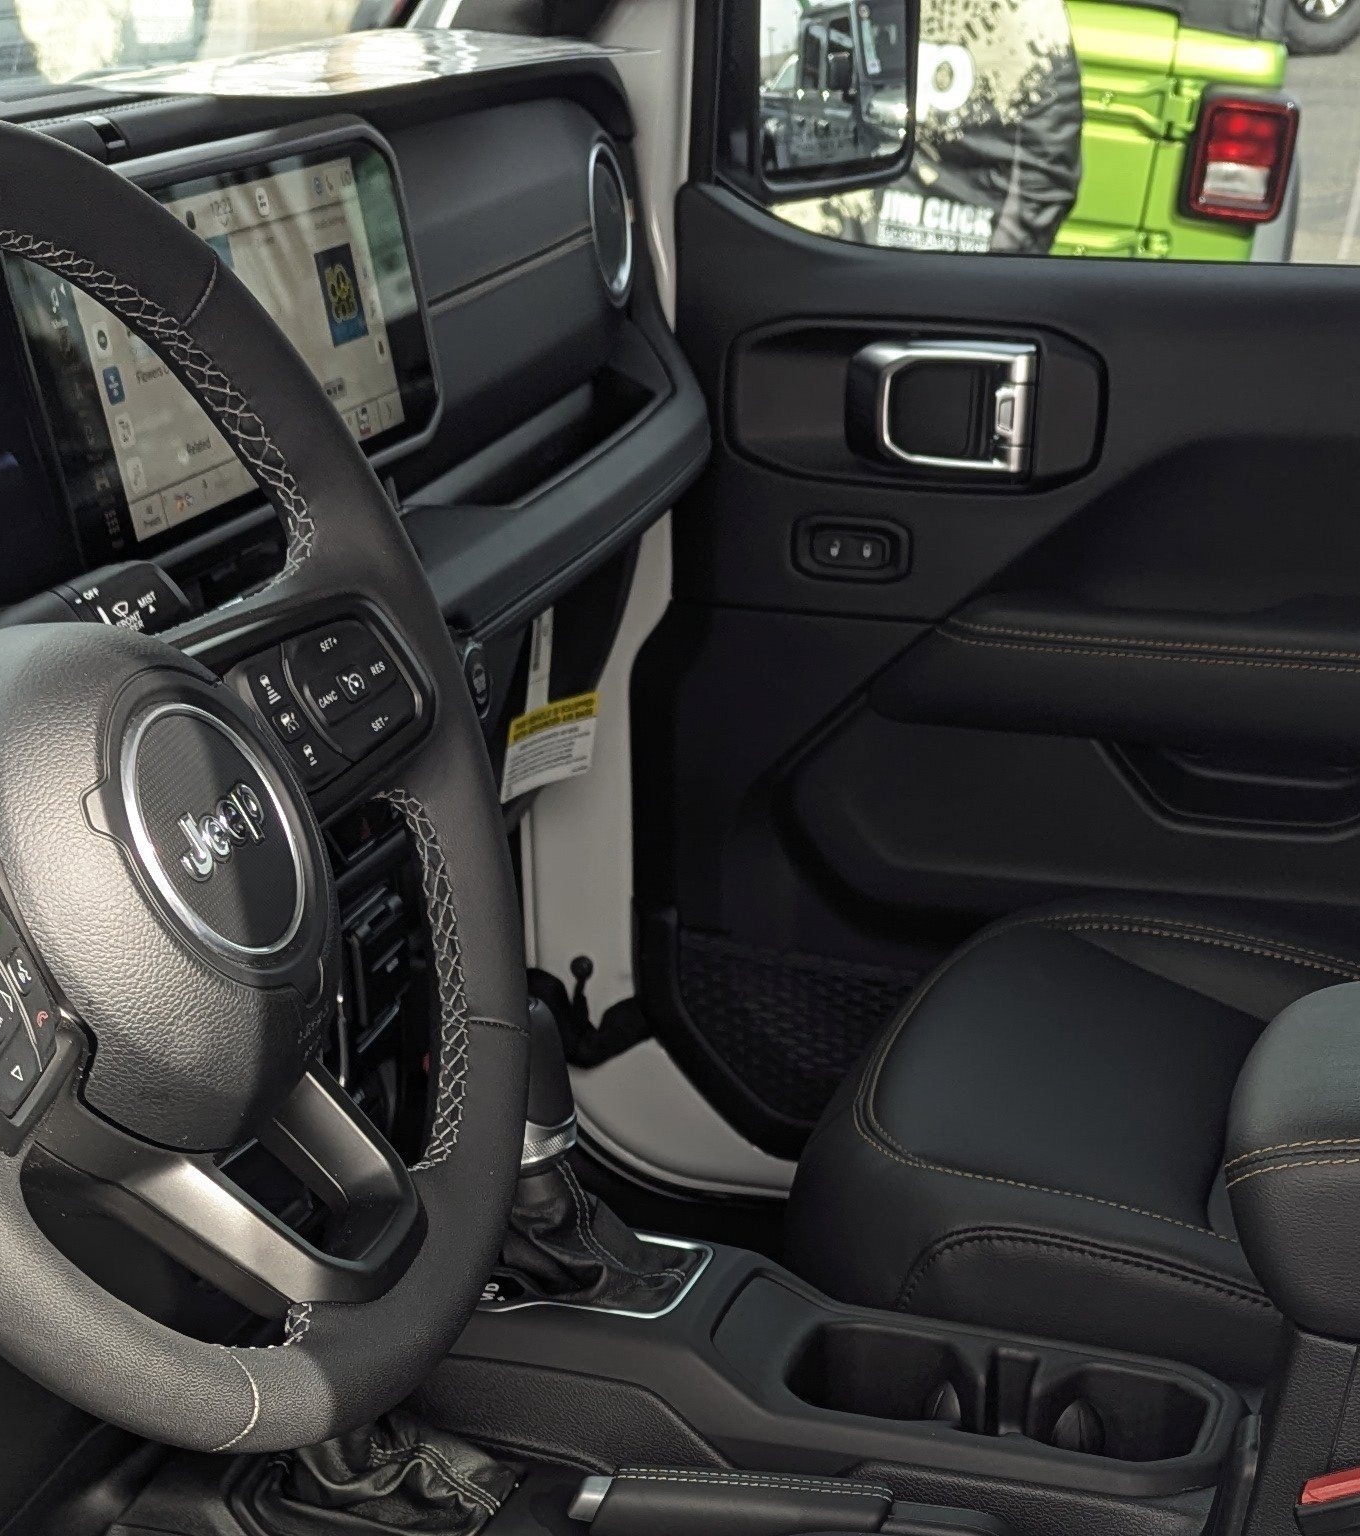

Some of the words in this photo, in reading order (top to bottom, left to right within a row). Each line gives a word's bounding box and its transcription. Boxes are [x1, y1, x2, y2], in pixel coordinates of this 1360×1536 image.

[82, 587, 100, 601] OFF
[136, 590, 157, 609] MIST
[369, 661, 386, 676] RES
[318, 690, 338, 709] CANC
[178, 780, 266, 882] Jeep
